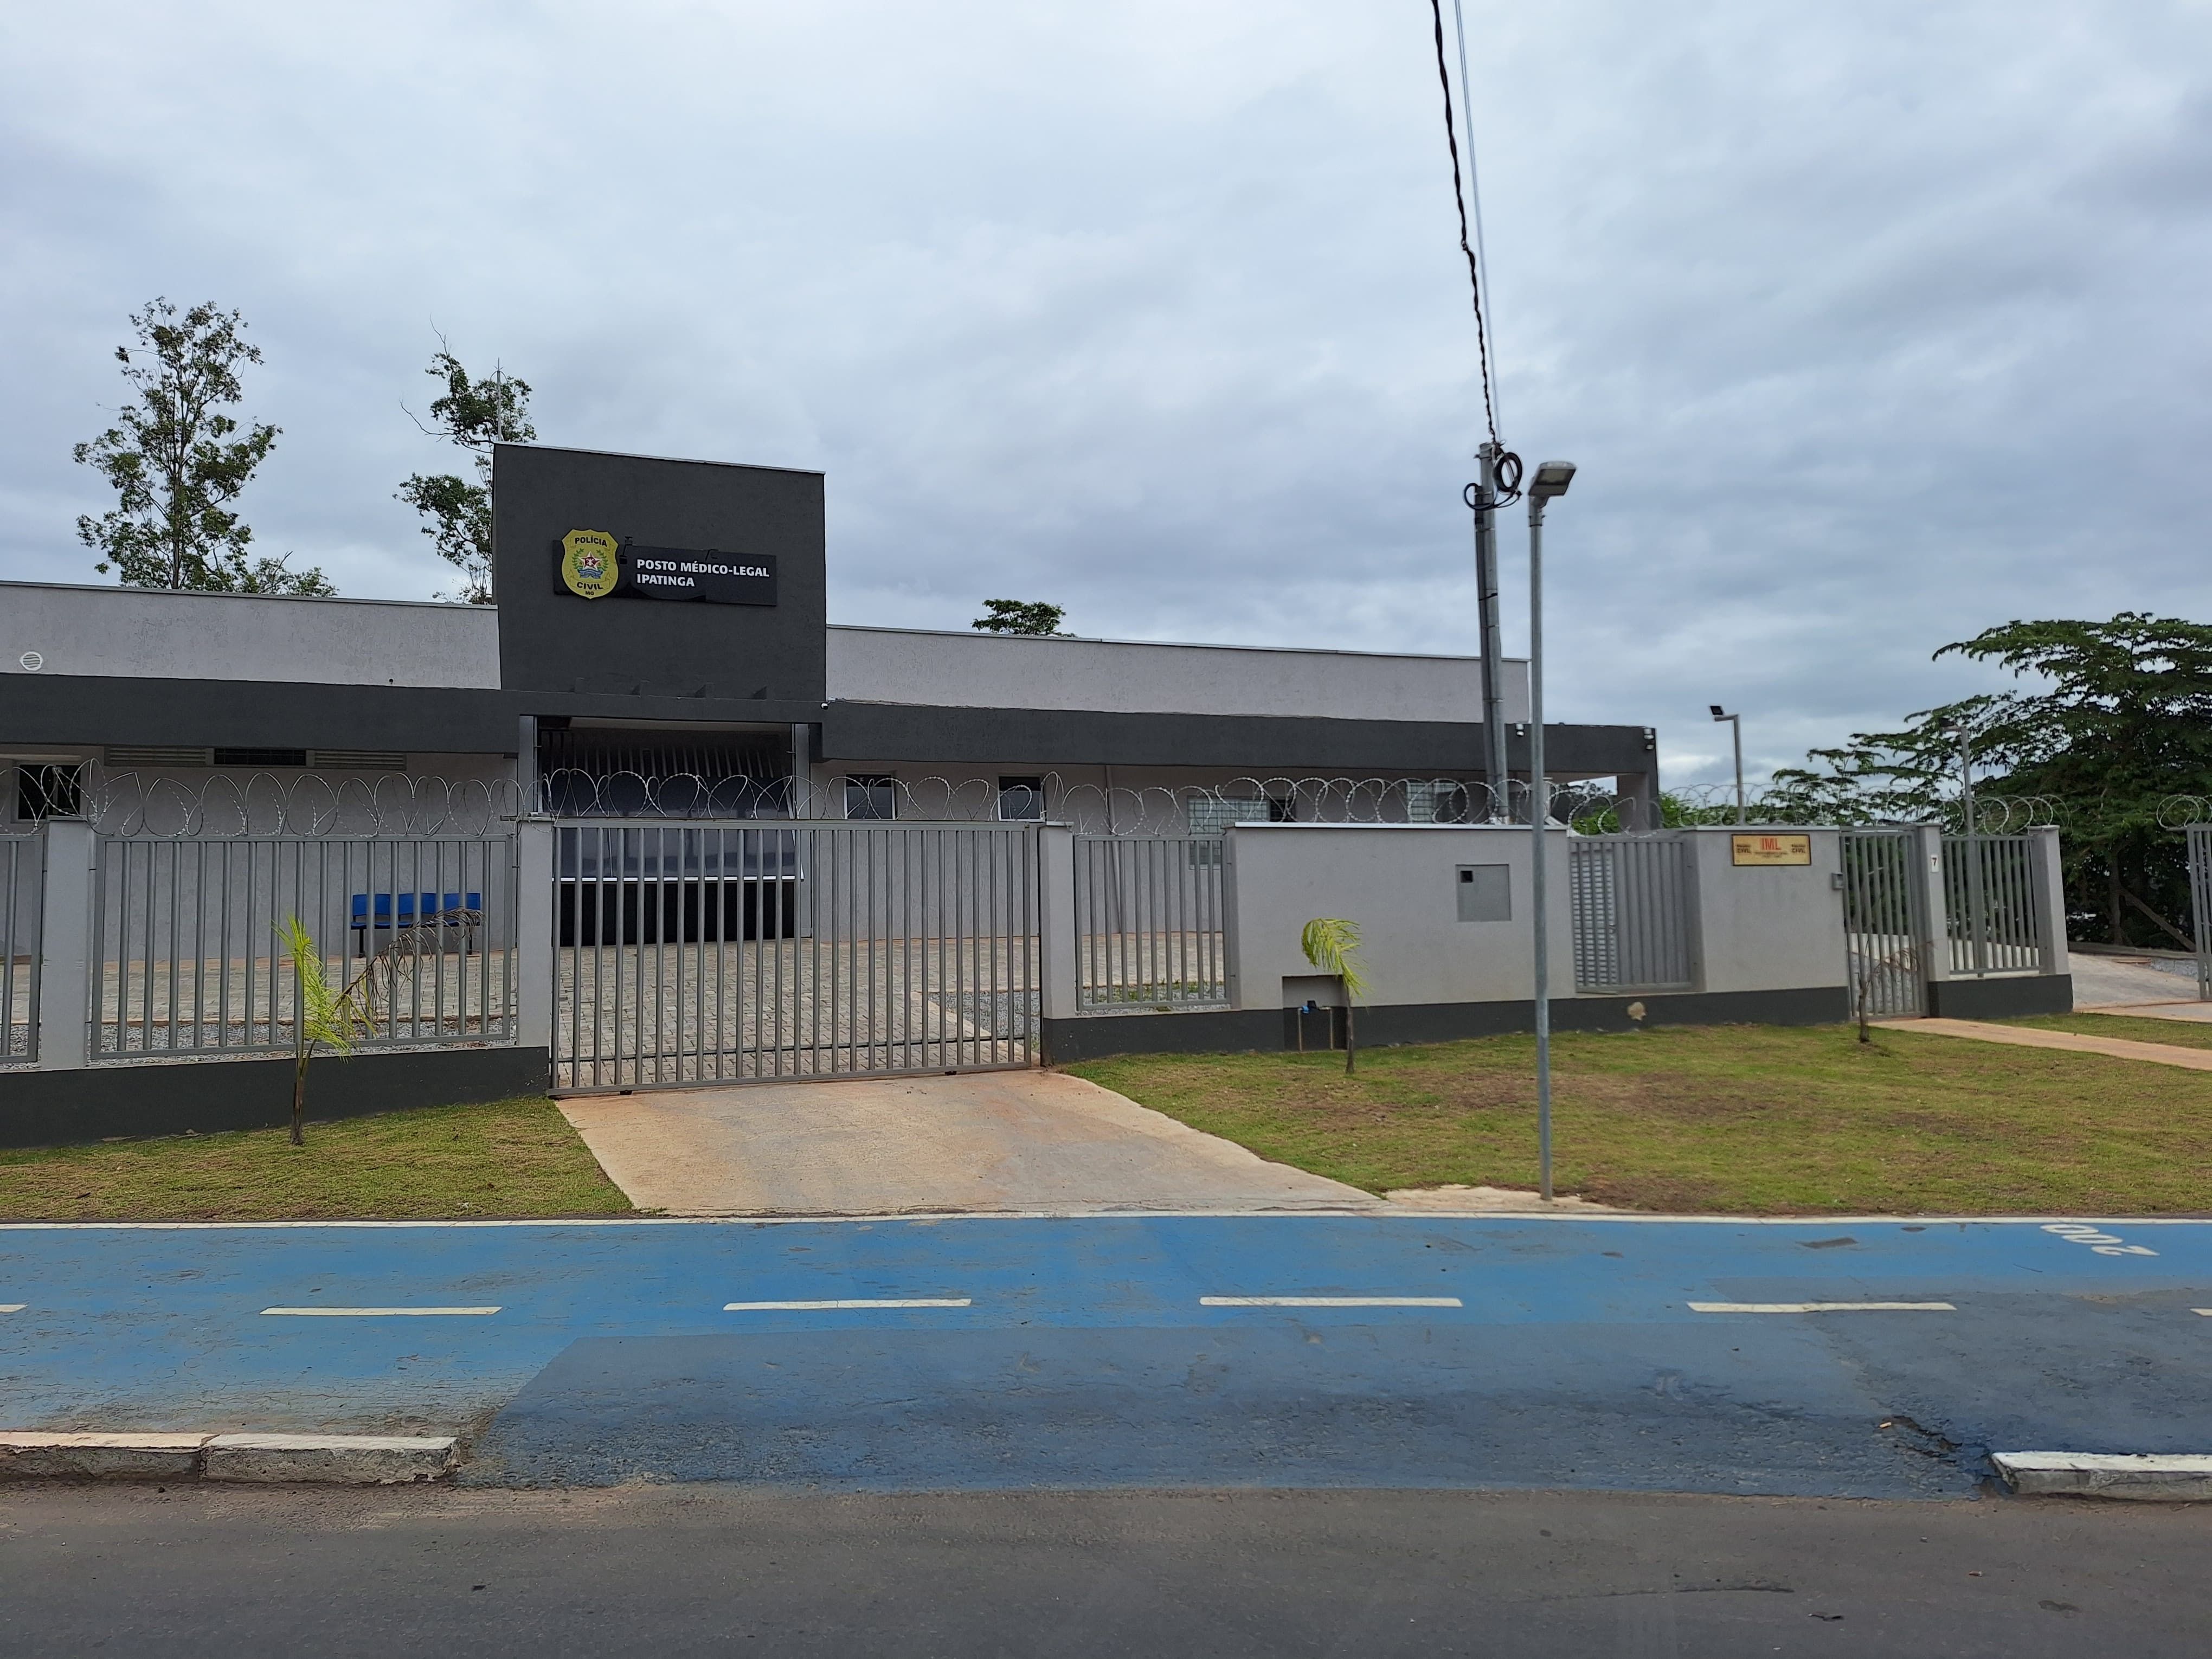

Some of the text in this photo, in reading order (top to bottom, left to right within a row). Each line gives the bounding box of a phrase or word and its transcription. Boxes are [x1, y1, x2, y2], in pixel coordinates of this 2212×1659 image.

[575, 535, 608, 548] POLÍCIA
[636, 559, 770, 577] POSTO MÉDICO-LEGAL
[576, 582, 604, 590] CIVIL
[636, 574, 695, 587] IPATINGA
[1761, 838, 1782, 851] IML
[1932, 857, 1937, 866] 7
